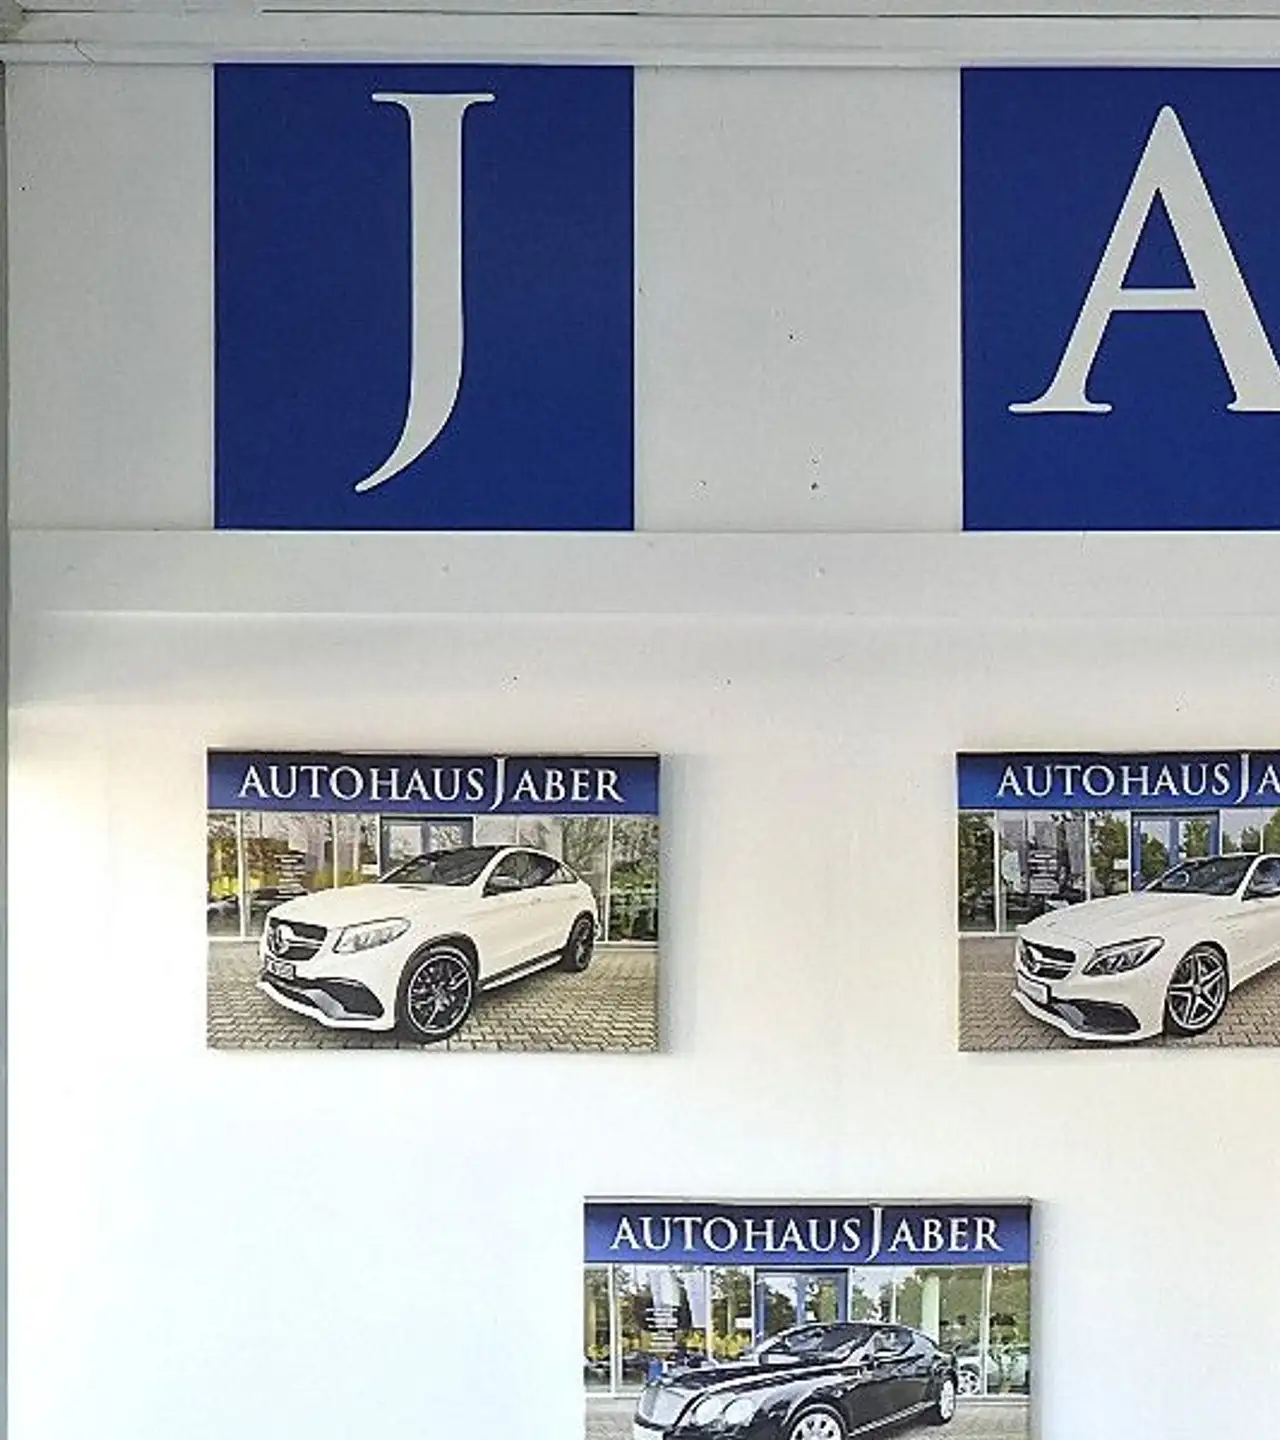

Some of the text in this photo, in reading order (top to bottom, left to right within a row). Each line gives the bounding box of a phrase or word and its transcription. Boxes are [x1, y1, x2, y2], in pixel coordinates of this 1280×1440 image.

[238, 757, 627, 811] AUTOHAUS JABER
[996, 763, 1230, 798] AUTOHAUS
[609, 1206, 1005, 1264] AUTOHAUS JABER
